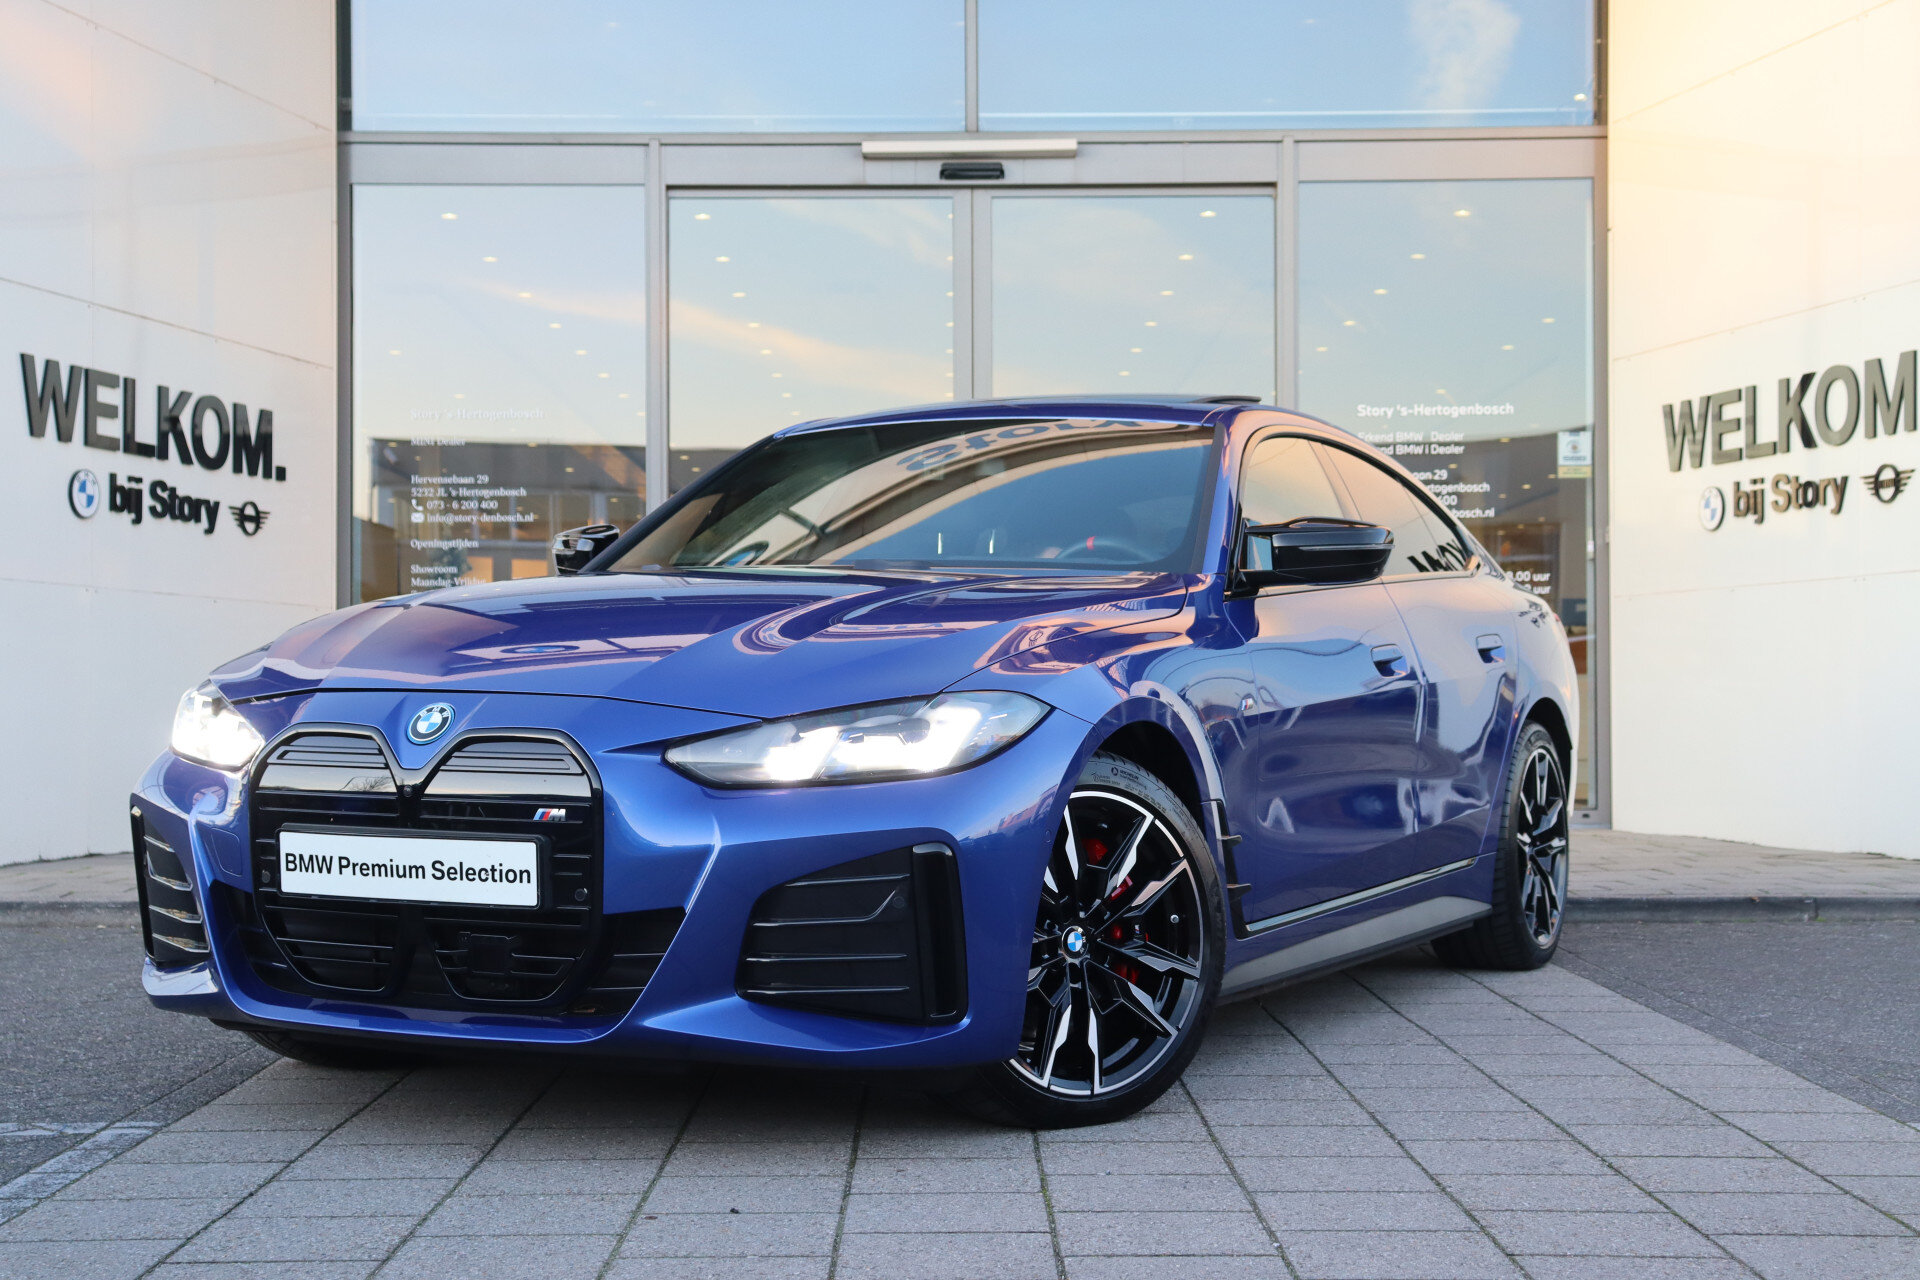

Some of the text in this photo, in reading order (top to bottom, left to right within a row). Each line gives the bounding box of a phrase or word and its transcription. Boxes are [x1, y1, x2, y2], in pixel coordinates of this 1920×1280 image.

[1357, 403, 1514, 419] Story 's-Hertogenbosch
[1662, 349, 1918, 472] WELKOM
[1396, 431, 1424, 442] BMW
[1430, 431, 1465, 442] Dealer
[1395, 444, 1425, 455] BMW
[1430, 443, 1465, 454] Dealer
[410, 474, 490, 484] Hervensebaan 29
[1433, 469, 1448, 480] 29
[411, 487, 435, 497] 5232
[1427, 482, 1490, 495] rtogenbosch
[109, 472, 220, 535] bij Story
[1733, 473, 1849, 525] bij Story
[426, 500, 445, 510] 073
[451, 500, 460, 510] 6
[460, 500, 479, 510] 200
[480, 500, 499, 510] 400
[410, 539, 480, 551] Openingstijden
[410, 564, 458, 574] Showroom
[1532, 572, 1551, 582] uur
[1533, 585, 1551, 595] uur
[285, 853, 532, 884] BMW Premium Selection
